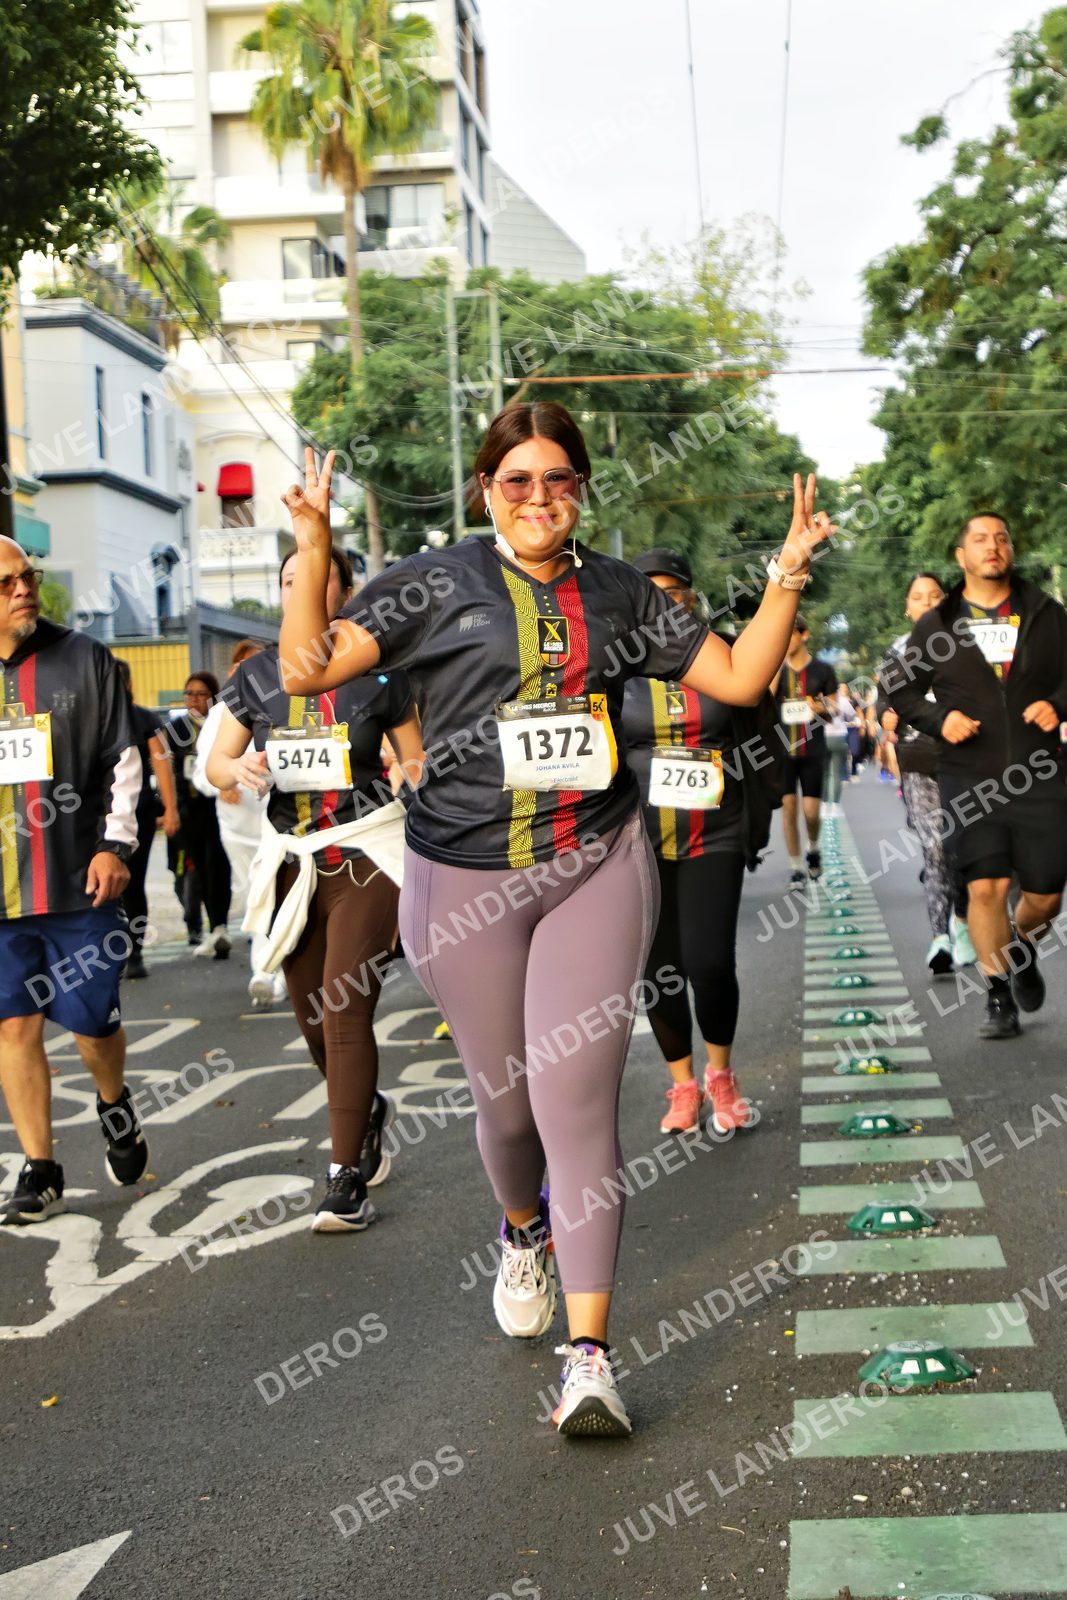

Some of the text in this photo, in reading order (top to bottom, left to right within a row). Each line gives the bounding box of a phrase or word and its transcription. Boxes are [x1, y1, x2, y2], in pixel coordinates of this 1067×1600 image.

[511, 703, 533, 711] LENES
[516, 725, 593, 761] 1372
[278, 747, 331, 770] 5474
[661, 767, 709, 788] 2763
